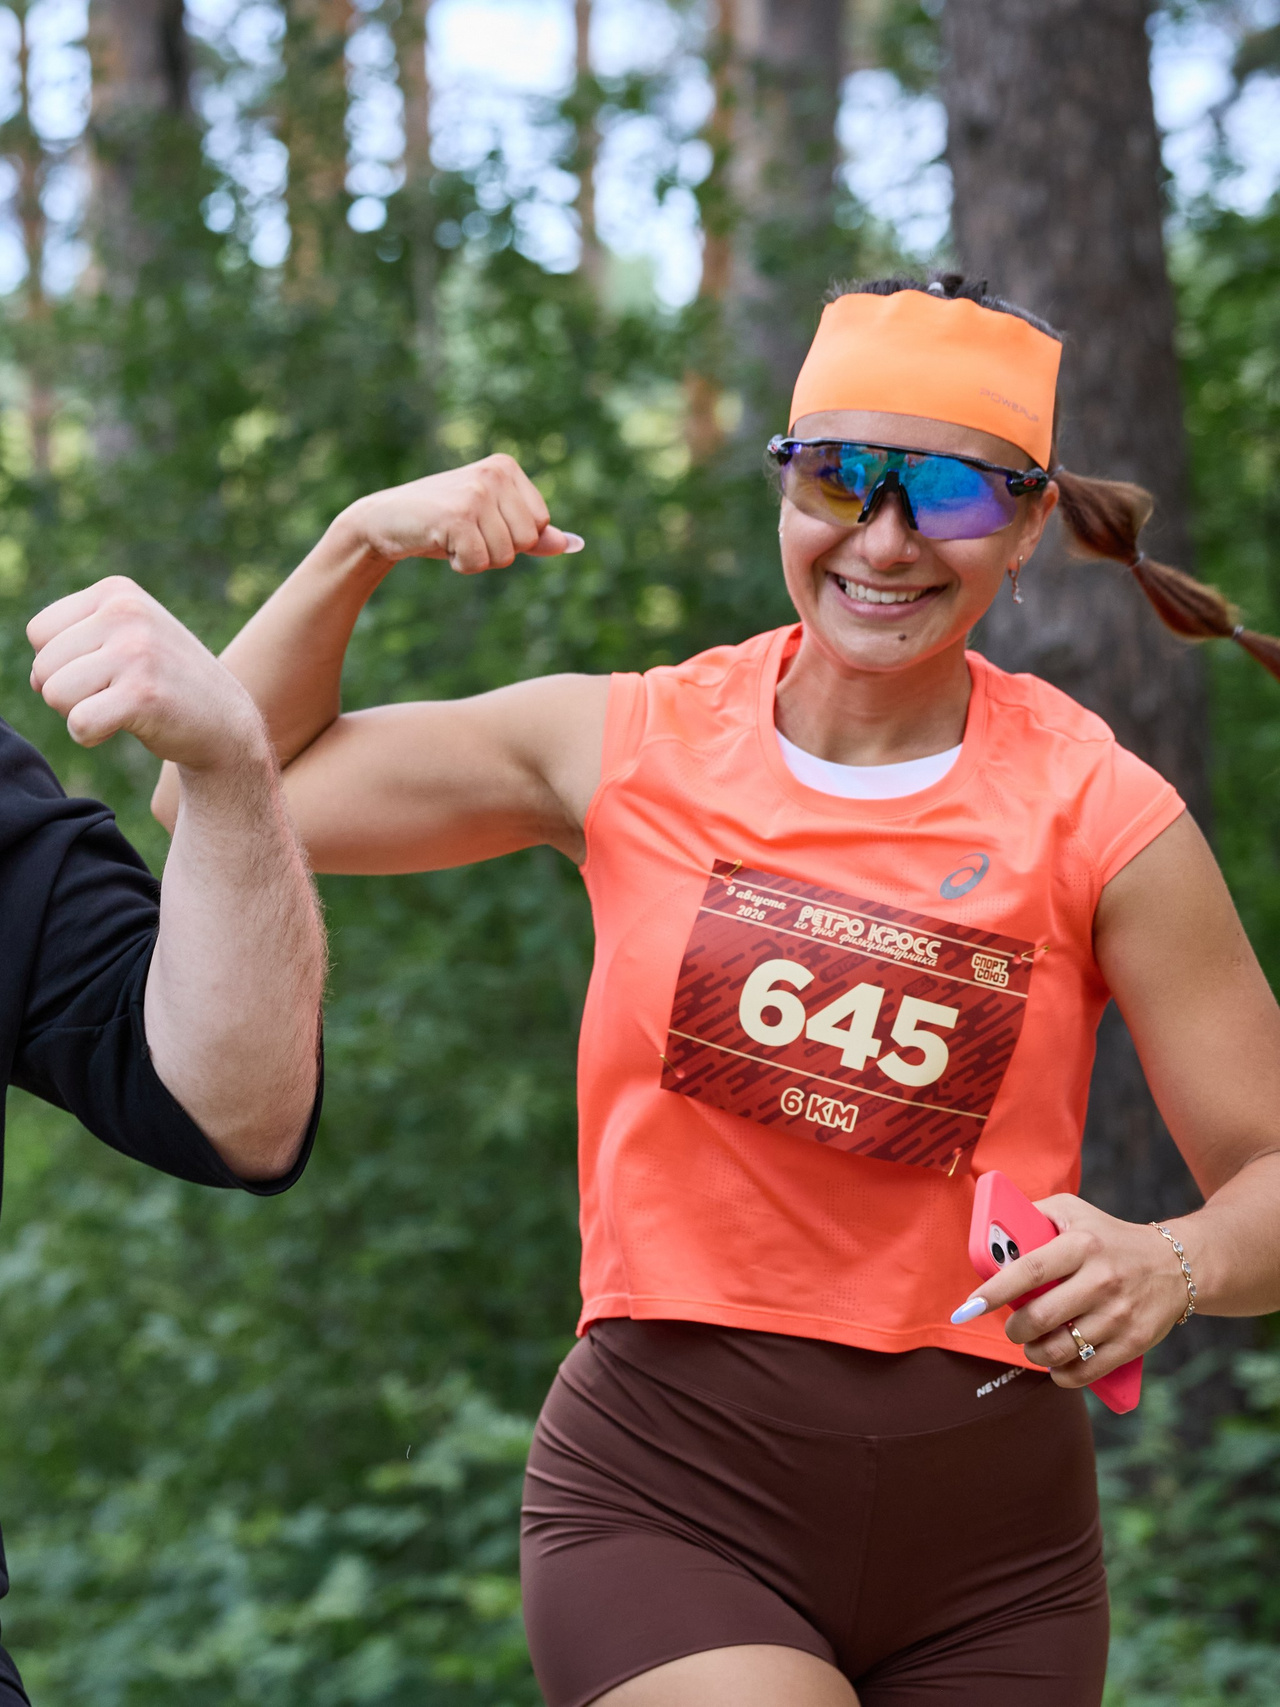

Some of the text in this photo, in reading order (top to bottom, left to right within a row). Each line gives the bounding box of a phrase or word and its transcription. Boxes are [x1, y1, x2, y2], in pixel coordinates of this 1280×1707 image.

[726, 885, 787, 911] 9 августа
[736, 905, 767, 921] 2026
[793, 919, 812, 932] ко
[811, 924, 837, 939] дню
[838, 931, 938, 967] физкультурника
[797, 905, 942, 959] РЕТРО КРОСС
[973, 955, 1007, 973] СПОРТ
[976, 968, 1008, 985] СОЮЗ
[738, 958, 960, 1087] 645
[780, 1087, 806, 1116] 6
[805, 1094, 859, 1133] КМ
